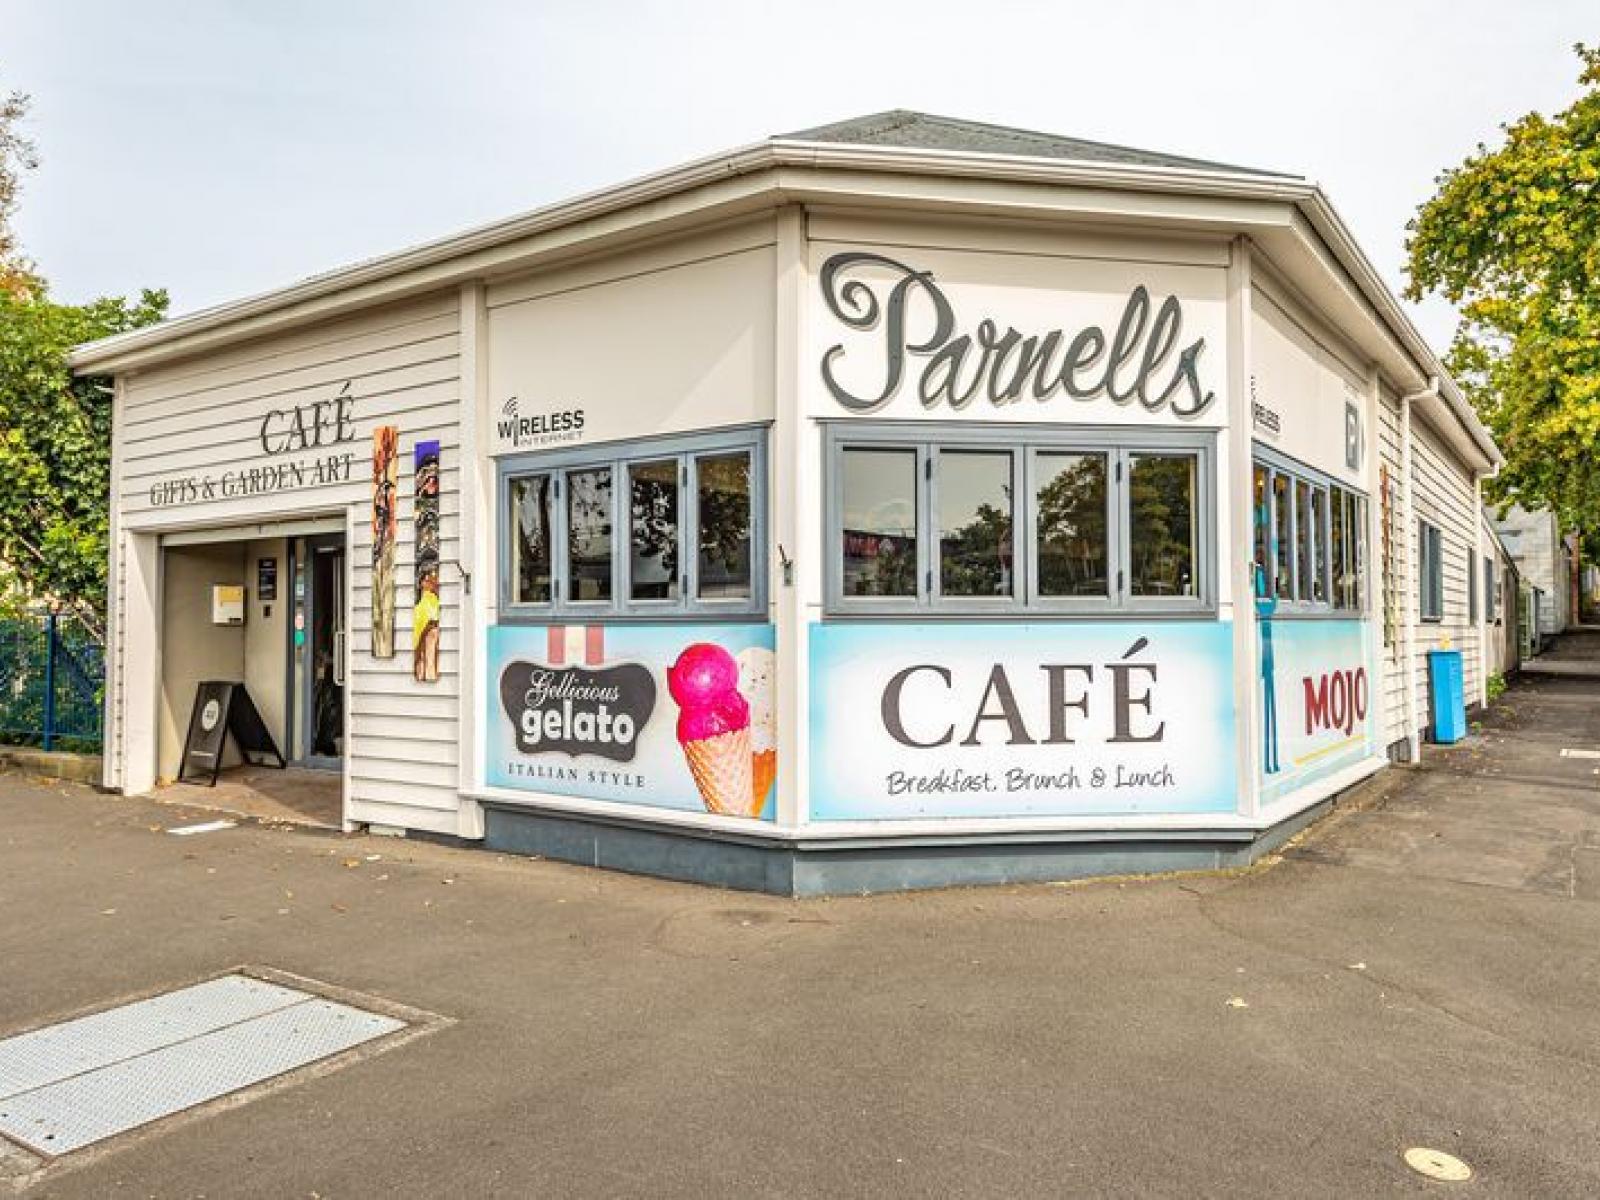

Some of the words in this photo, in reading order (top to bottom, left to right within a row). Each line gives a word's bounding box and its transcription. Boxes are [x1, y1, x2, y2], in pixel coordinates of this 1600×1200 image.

[819, 252, 1216, 417] Parnells
[260, 380, 356, 456] CAFÉ
[497, 409, 585, 445] WIRELESS
[150, 477, 197, 506] GIFTS
[201, 475, 215, 499] &
[222, 459, 305, 497] GARDEN
[310, 453, 354, 486] ART
[880, 636, 1165, 749] CAFÉ
[1303, 666, 1368, 737] MOJO
[521, 700, 635, 745] gelato
[508, 762, 579, 780] ITALIAN
[587, 770, 646, 788] STYLE
[1005, 766, 1082, 793] Brunch
[1090, 766, 1107, 787] &
[1114, 764, 1175, 789] Lunch
